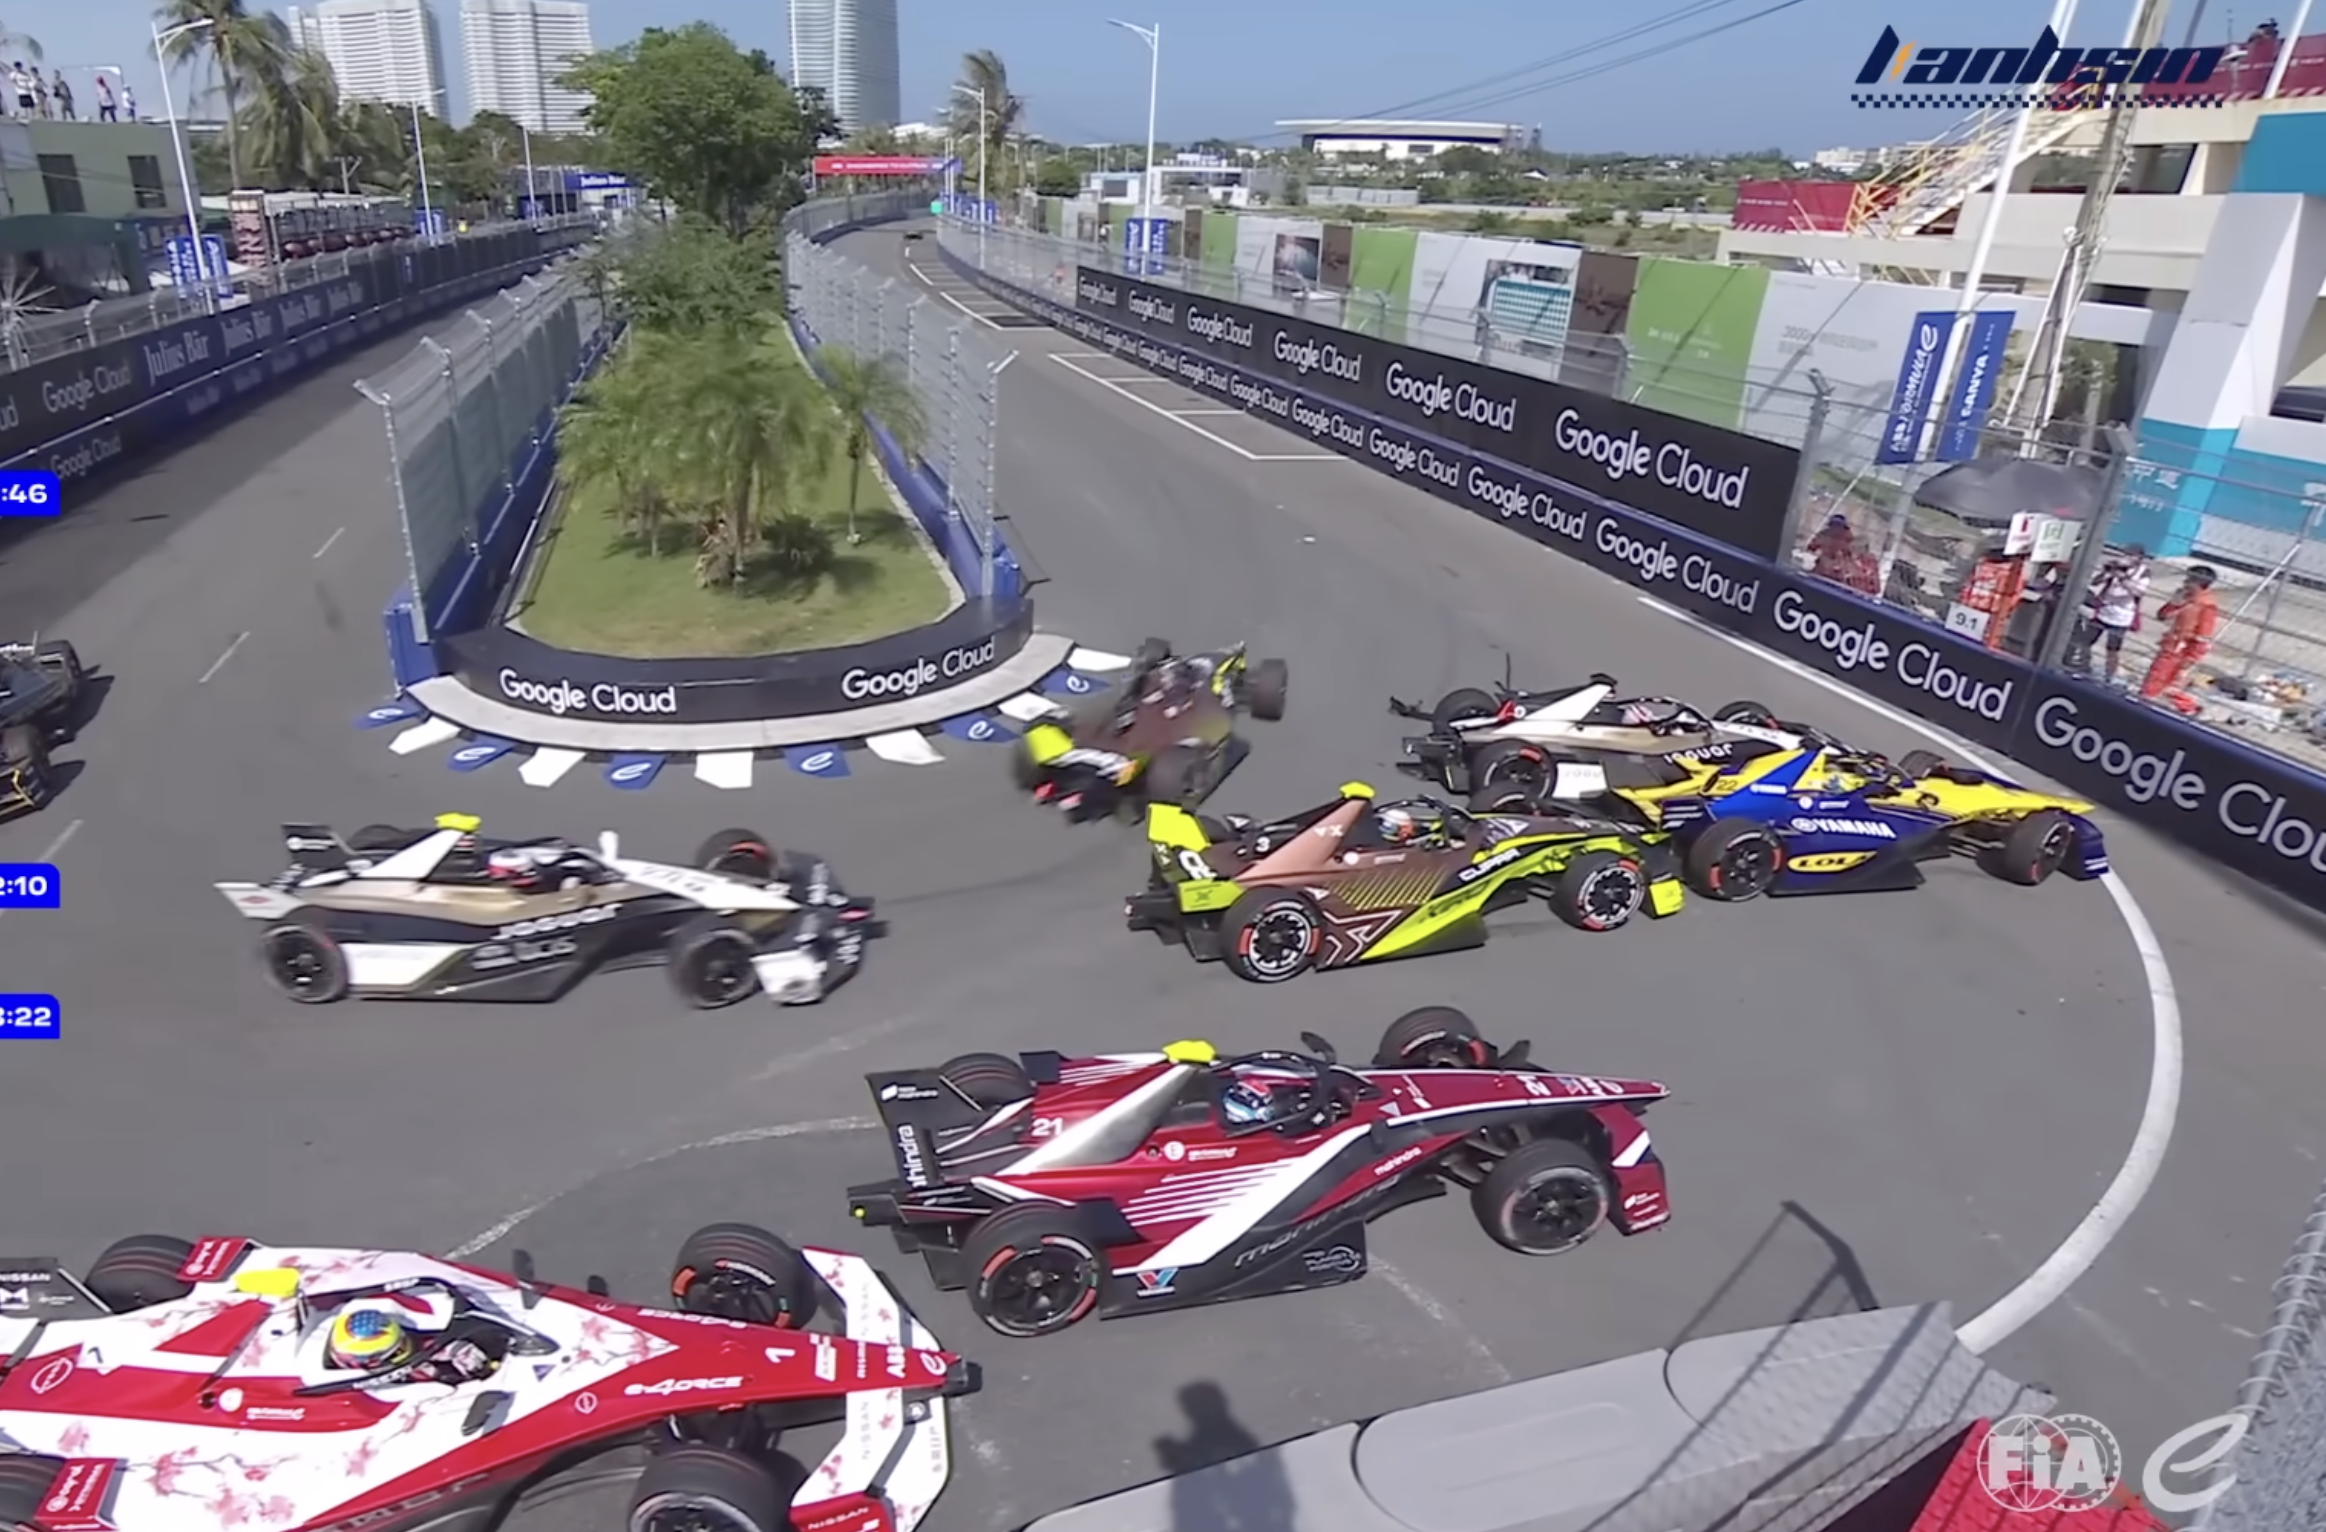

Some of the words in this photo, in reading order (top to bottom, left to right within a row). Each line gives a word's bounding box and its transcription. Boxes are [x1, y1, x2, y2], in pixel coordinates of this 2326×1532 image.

[1129, 290, 1153, 321] Google
[1153, 298, 1175, 324] Cloud
[1187, 306, 1223, 342] Google
[1224, 316, 1253, 348] Cloud
[143, 338, 185, 387] Julius
[1178, 353, 1205, 384] Google
[1205, 365, 1228, 392] Cloud
[1274, 331, 1320, 374] Google
[1321, 344, 1362, 382] Cloud
[42, 370, 94, 413] Google
[94, 359, 132, 394] Cloud
[1230, 374, 1261, 408] Google
[1262, 387, 1289, 417] Cloud
[1386, 362, 1451, 416] Google
[1454, 383, 1517, 432] Cloud
[1292, 398, 1329, 436] Google
[1330, 413, 1364, 448] Cloud
[1369, 428, 1417, 472] Google
[1418, 448, 1461, 488] Cloud
[1555, 408, 1649, 480] Google
[1656, 443, 1750, 509] Cloud
[1467, 466, 1529, 518] Google
[1530, 493, 1587, 541] Cloud
[1596, 517, 1678, 582] Google
[1682, 555, 1760, 614] Cloud
[1955, 612, 1978, 631] 9.1
[841, 657, 938, 699] Google
[942, 635, 996, 678] Cloud
[1774, 590, 1890, 670] Google
[1897, 643, 2014, 721] Cloud
[500, 668, 587, 715] Google
[591, 683, 677, 713] Cloud
[2034, 697, 2206, 810] Google
[1716, 779, 1739, 792] 22
[1255, 836, 1271, 853] 3
[1812, 818, 1897, 839] YAMAHA
[1458, 848, 1522, 882] CUPRA
[1031, 1117, 1063, 1137] 21
[1374, 1146, 1422, 1176] mahindra
[765, 1347, 796, 1364] 1
[808, 1506, 870, 1530] NISSAN
